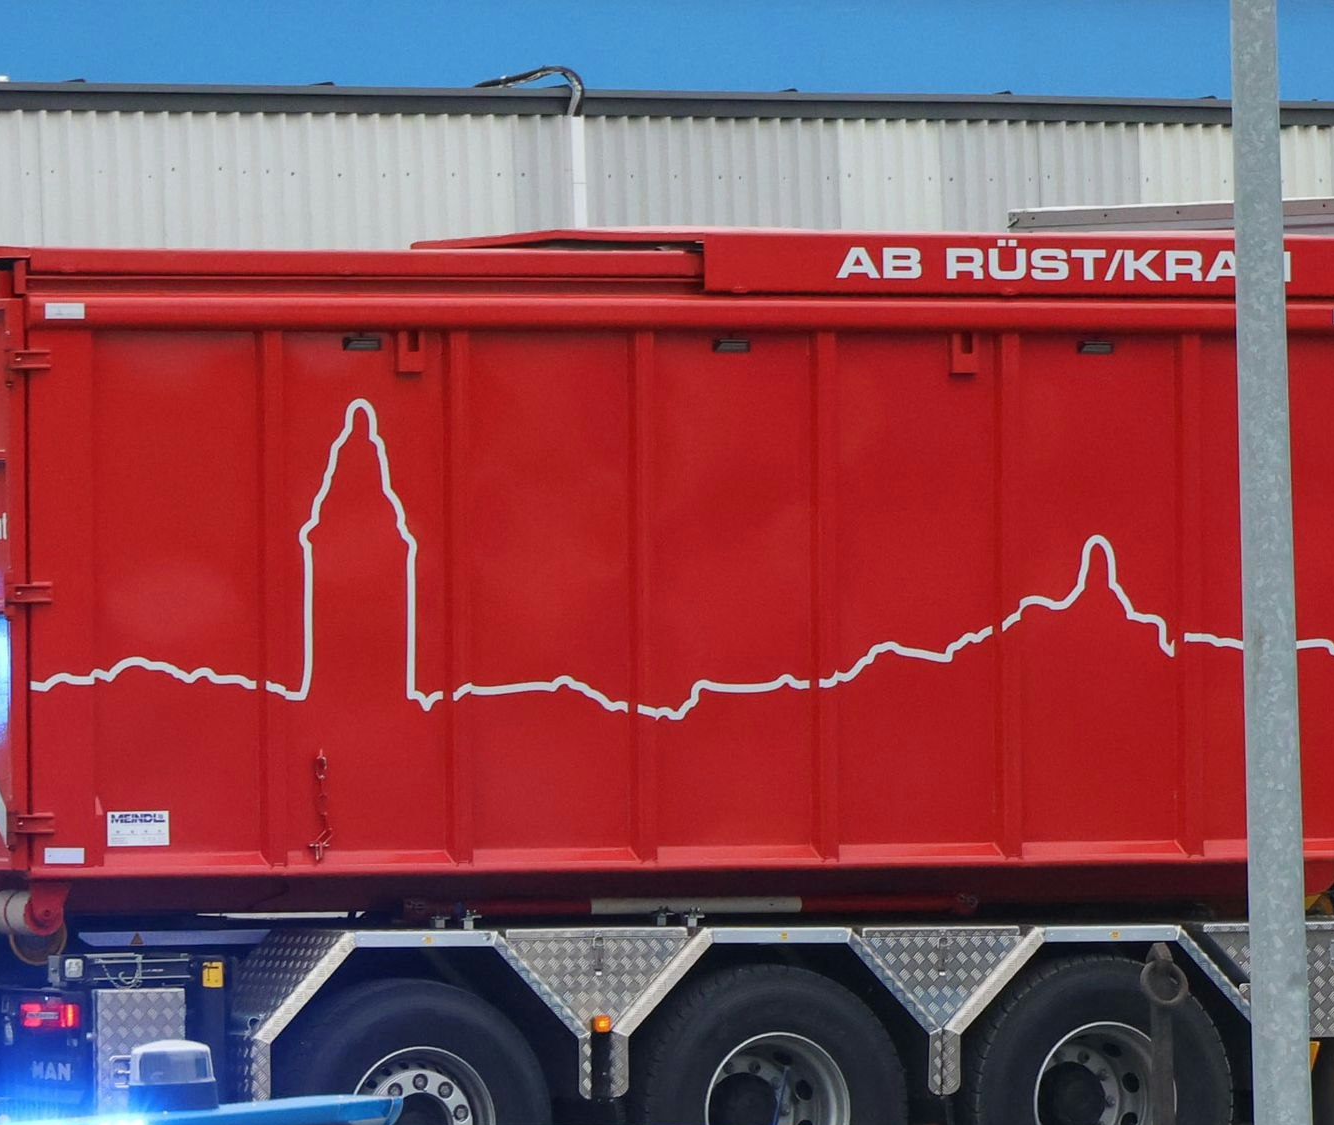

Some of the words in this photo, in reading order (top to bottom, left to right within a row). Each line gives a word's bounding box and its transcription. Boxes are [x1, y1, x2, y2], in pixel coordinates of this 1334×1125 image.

[836, 247, 922, 279] AB
[946, 239, 1290, 282] RÜST/KRA
[32, 1060, 72, 1081] MAN
